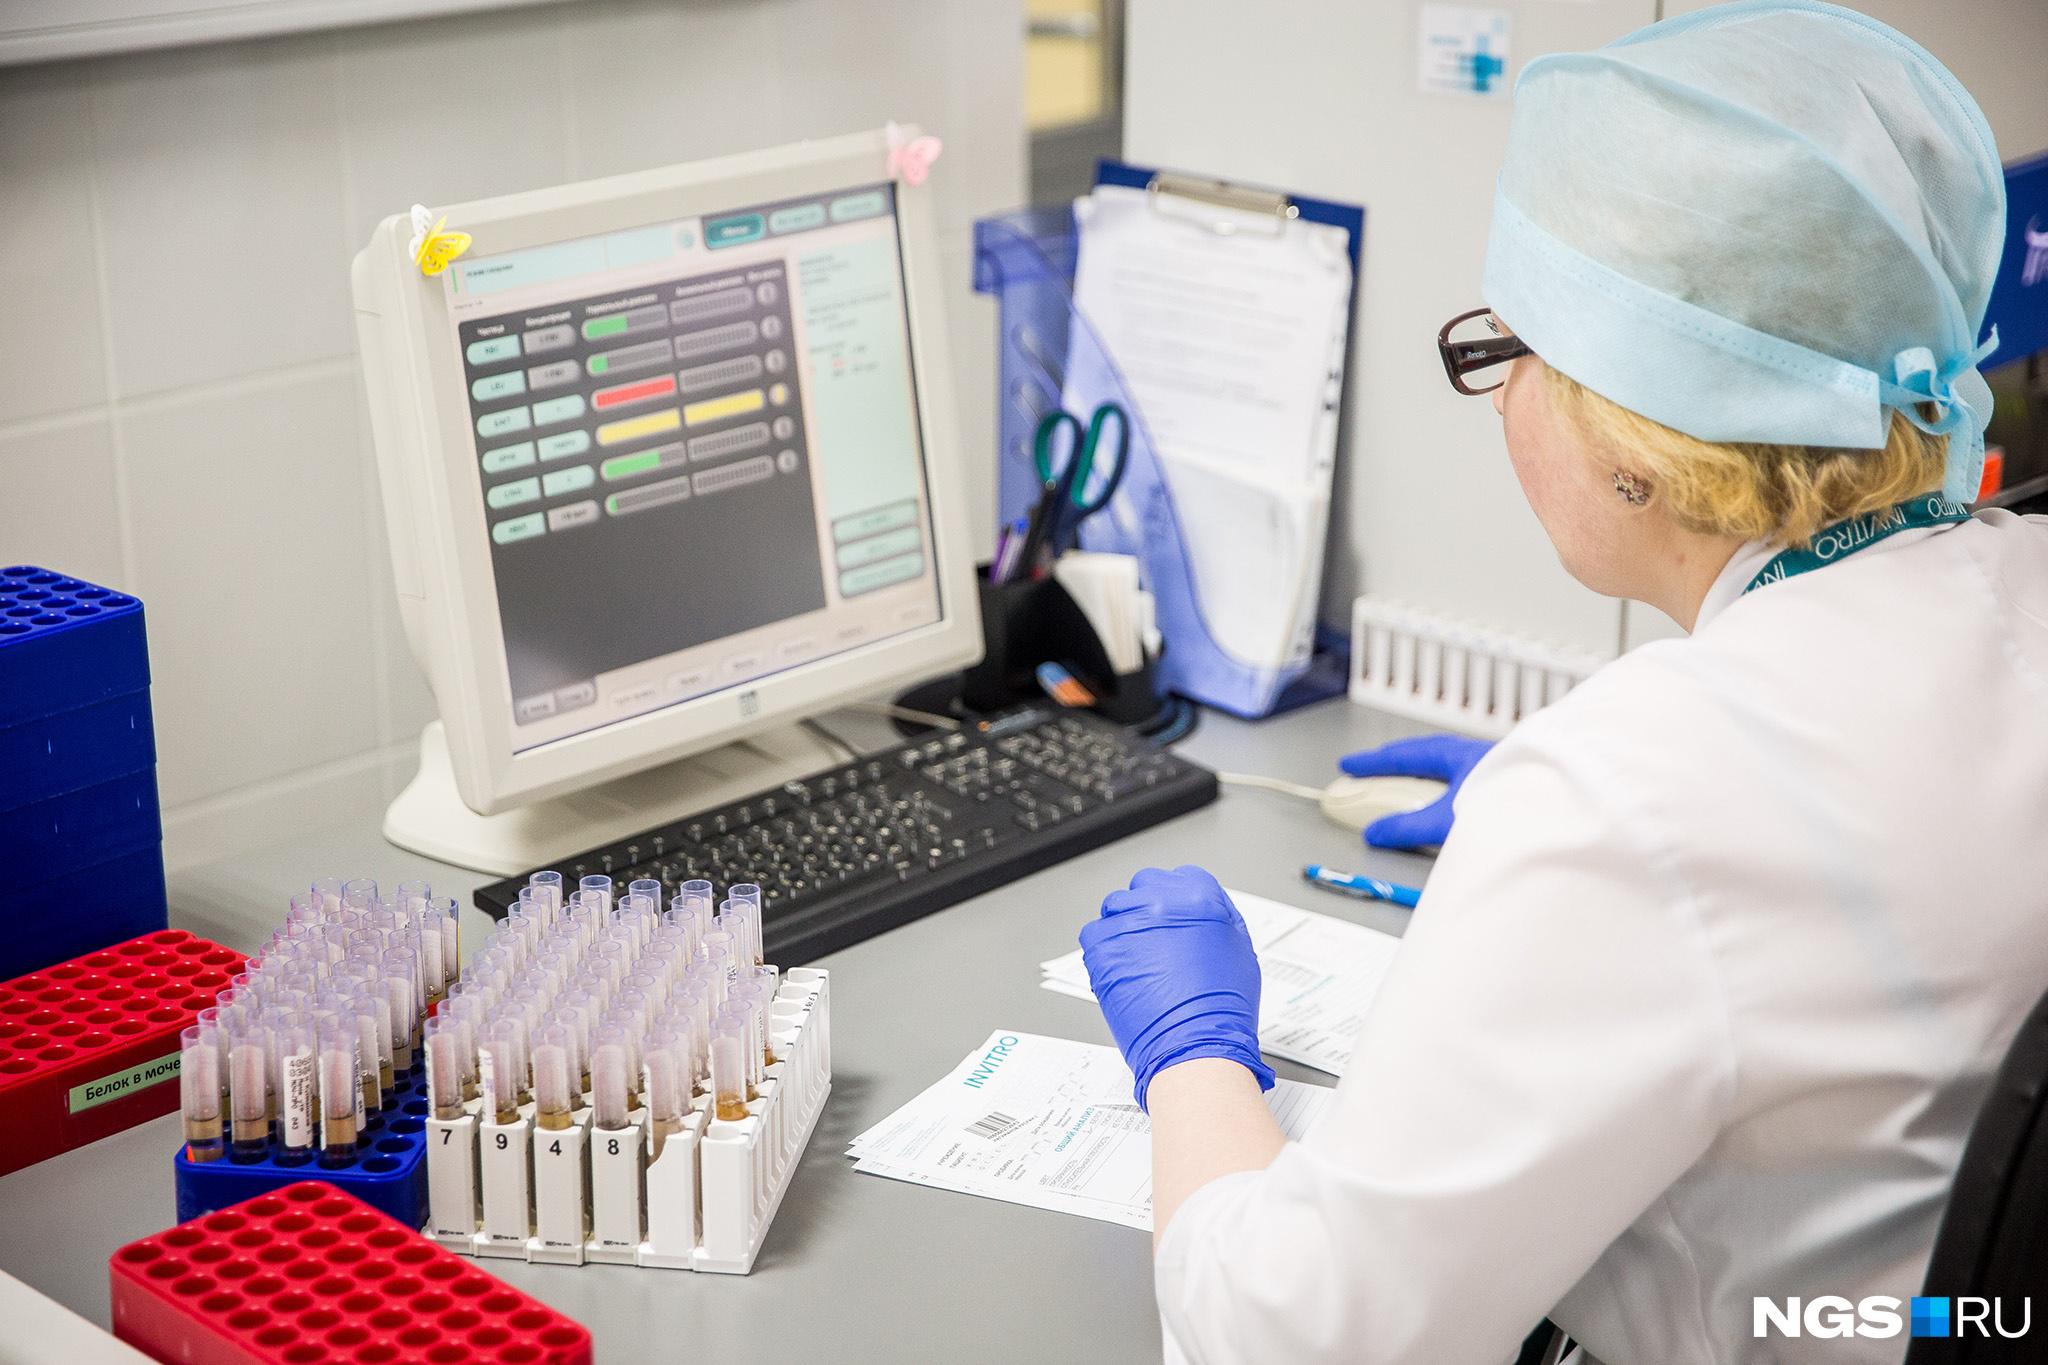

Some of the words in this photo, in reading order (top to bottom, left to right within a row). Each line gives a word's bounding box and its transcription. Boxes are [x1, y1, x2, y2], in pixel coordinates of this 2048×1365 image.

[1815, 506, 1907, 559] INVITRO
[963, 1035, 1019, 1089] INVITRO
[86, 1077, 130, 1101] Белок
[133, 1073, 142, 1084] в
[145, 1059, 181, 1081] моче
[440, 1129, 454, 1147] 7
[495, 1134, 508, 1150] 9
[1054, 1129, 1076, 1153] ОБЩИЙ
[1072, 1106, 1095, 1131] АНАЛИЗ
[549, 1140, 562, 1156] 4
[607, 1139, 620, 1155] 8
